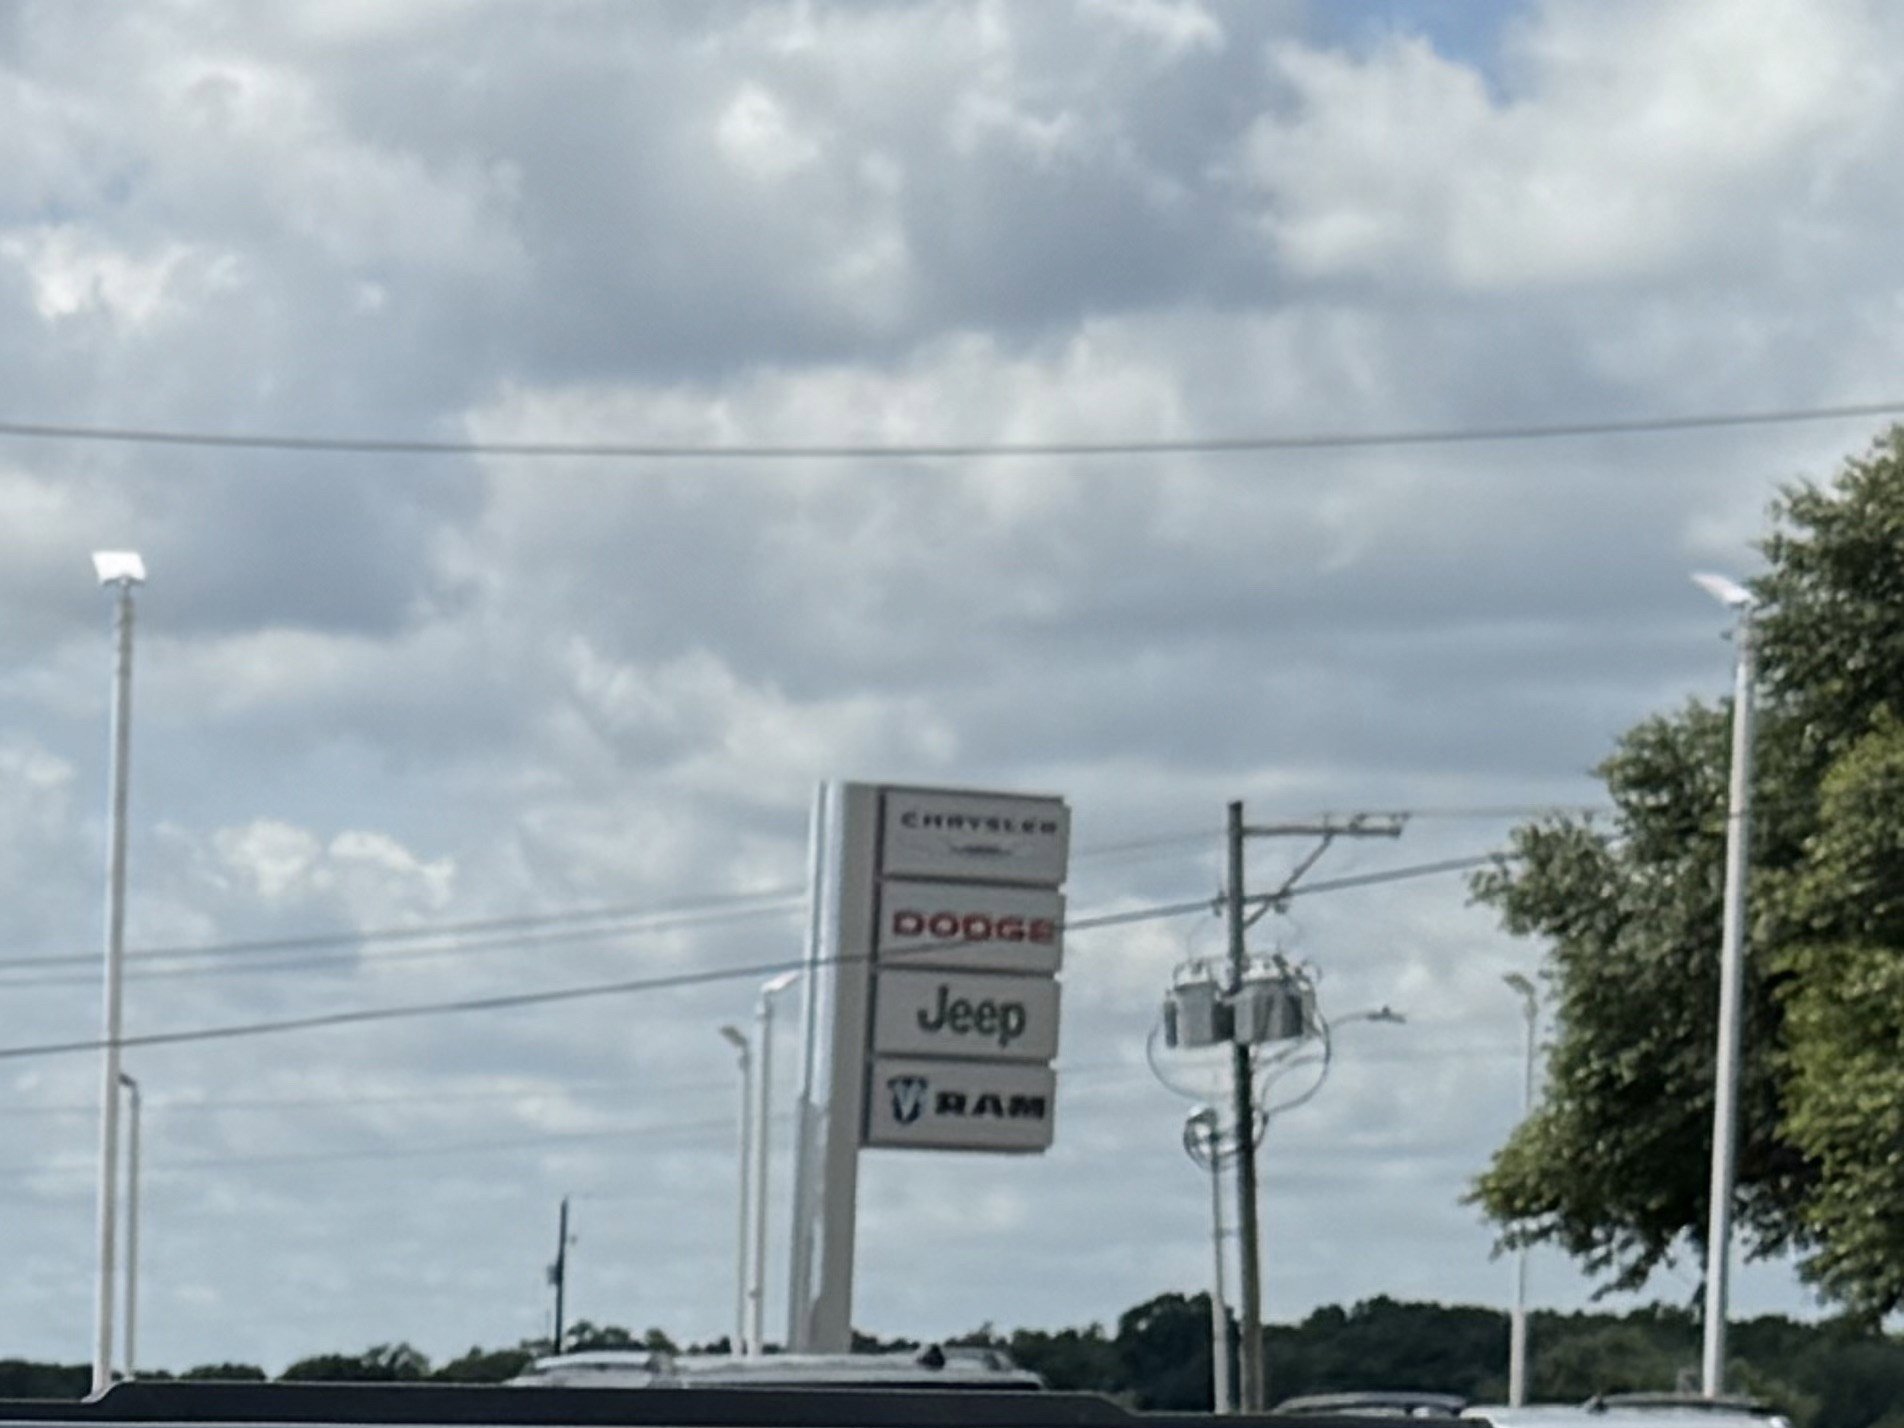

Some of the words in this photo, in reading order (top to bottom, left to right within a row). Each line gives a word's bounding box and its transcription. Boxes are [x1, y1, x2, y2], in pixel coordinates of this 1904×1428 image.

[900, 810, 1059, 834] CHRYSLER
[892, 909, 1057, 947] DODGE
[916, 983, 1027, 1048] Jeep
[933, 1089, 1047, 1121] RAM
